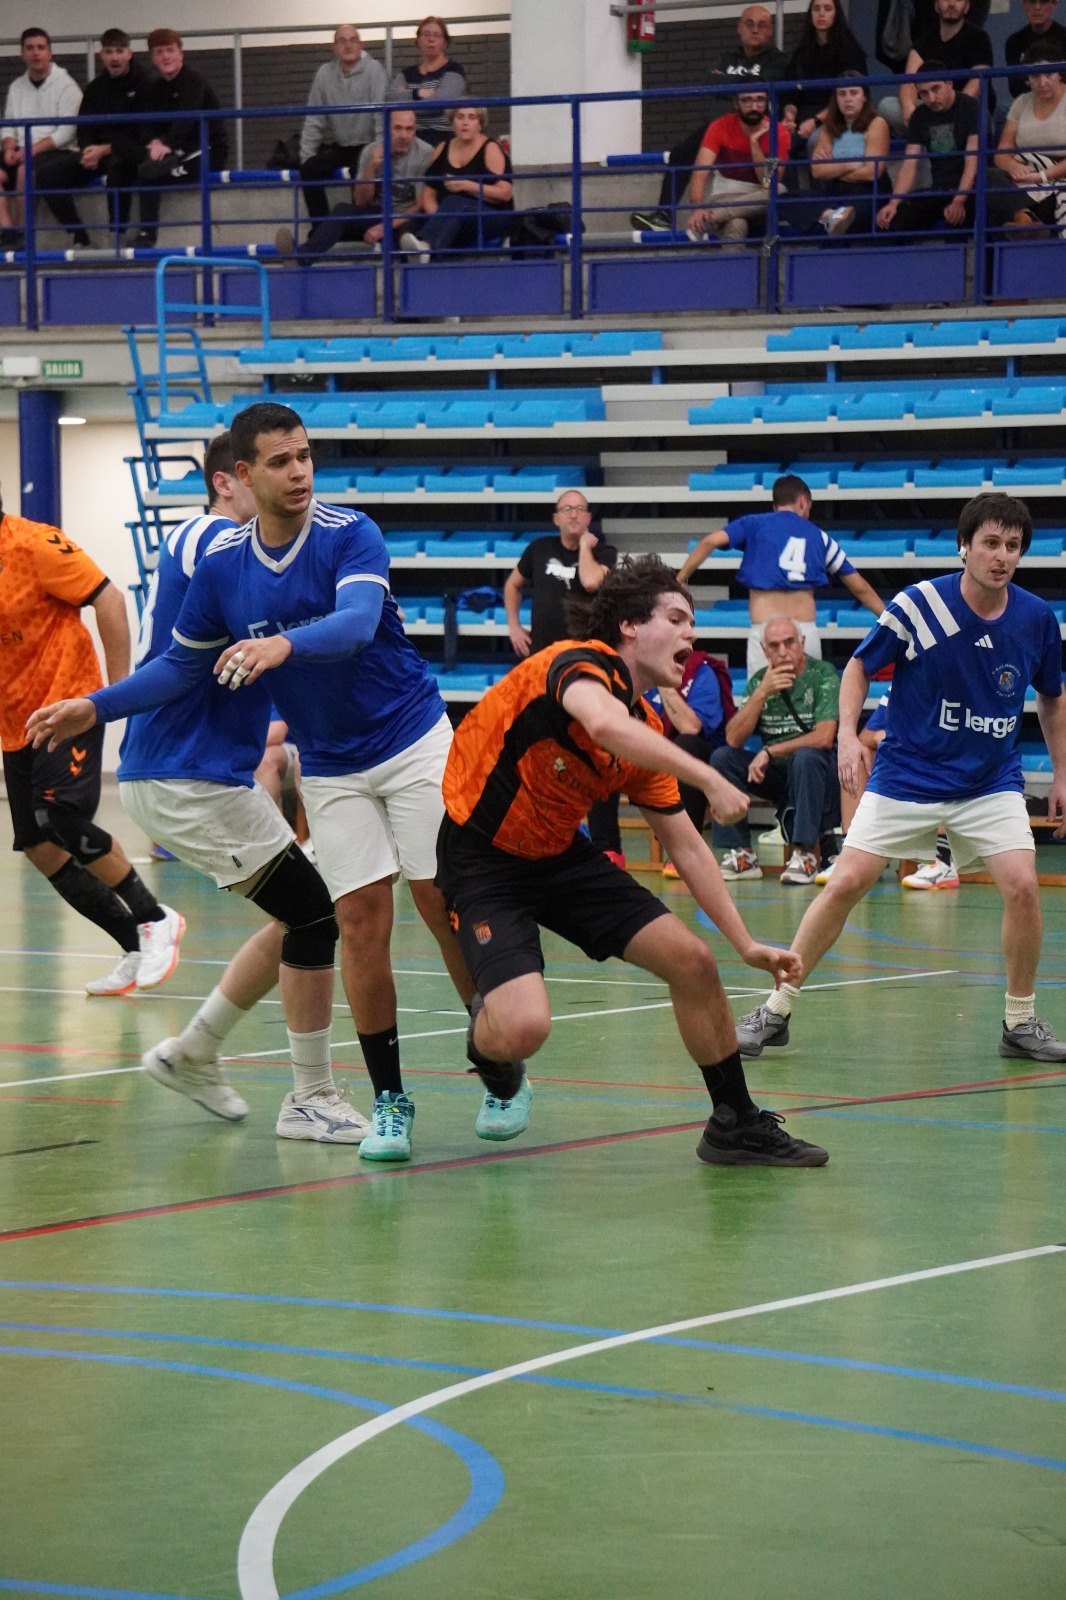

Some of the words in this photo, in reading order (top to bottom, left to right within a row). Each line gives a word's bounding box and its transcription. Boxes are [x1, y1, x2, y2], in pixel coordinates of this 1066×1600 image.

[45, 362, 81, 376] SALIDA
[779, 536, 807, 582] 4
[965, 708, 1017, 739] lerga
